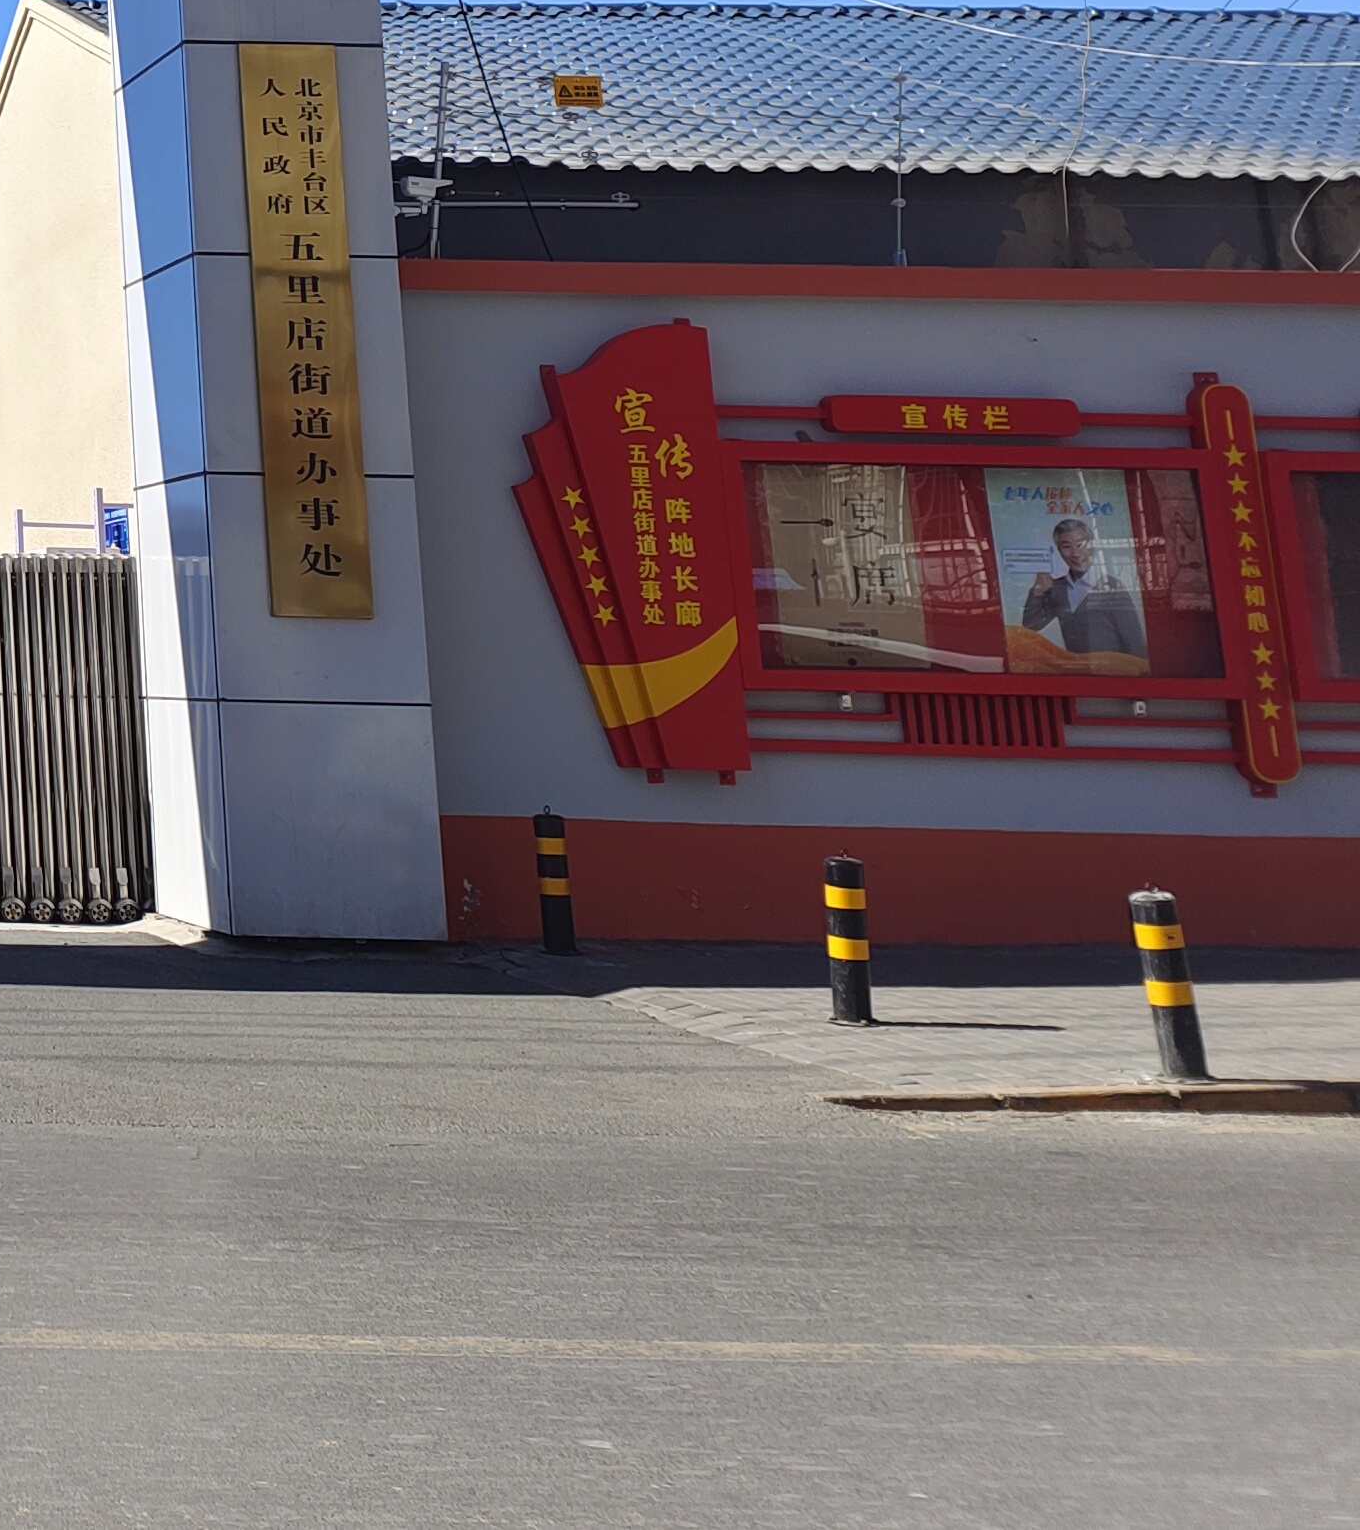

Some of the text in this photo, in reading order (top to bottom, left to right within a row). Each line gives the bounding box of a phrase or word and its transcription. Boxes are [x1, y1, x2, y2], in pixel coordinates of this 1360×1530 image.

[258, 77, 293, 216] 人民政府
[293, 77, 331, 216] 北京市丰台区
[279, 231, 344, 578] 五里店街道办事处
[614, 387, 694, 479] 宣传
[901, 403, 1011, 431] 宣传栏
[628, 443, 666, 626] 五里店街道办事处
[665, 497, 703, 627] 阵地长廊
[1237, 531, 1270, 633] 不忘初心
